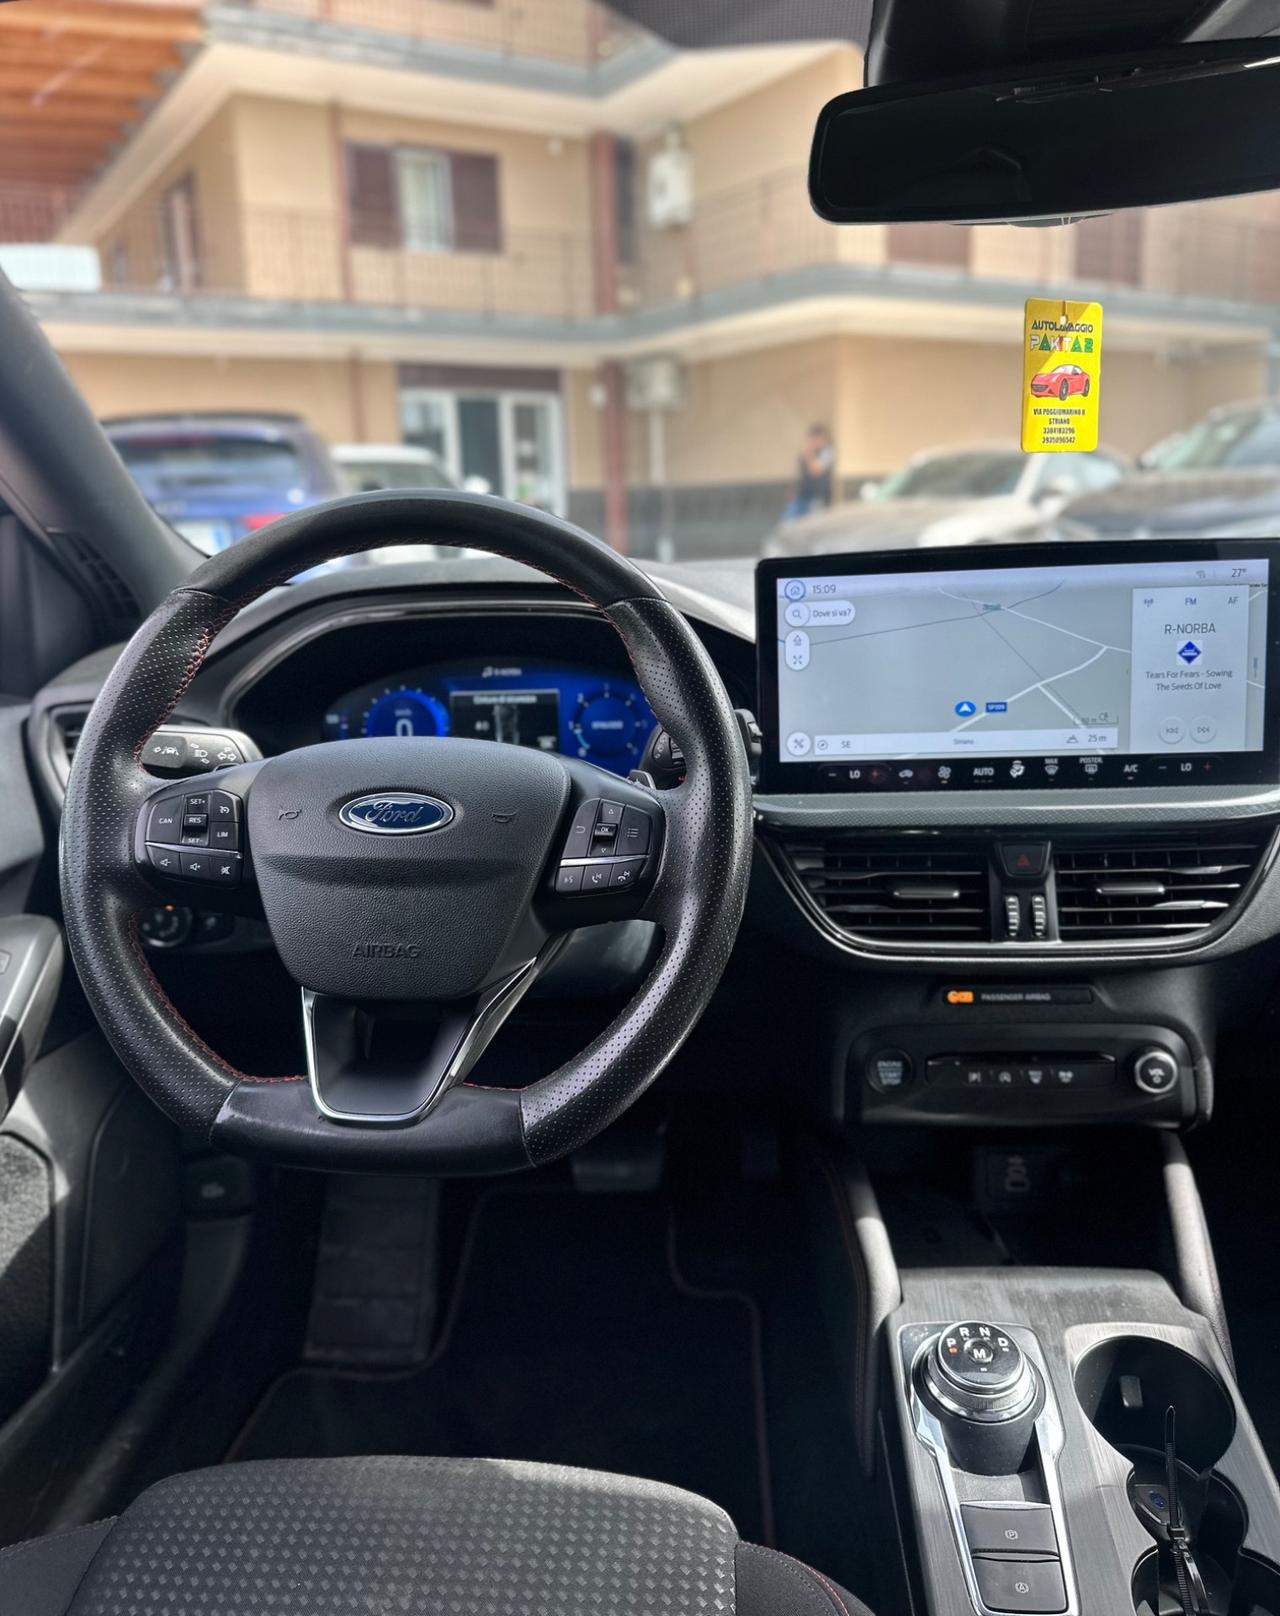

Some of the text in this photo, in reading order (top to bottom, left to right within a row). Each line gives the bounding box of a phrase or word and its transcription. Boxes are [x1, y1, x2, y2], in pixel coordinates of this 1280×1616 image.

[812, 584, 837, 594] 15:09
[1185, 597, 1197, 606] FM
[1228, 596, 1239, 605] AF
[812, 608, 831, 618] Dove
[1164, 623, 1216, 635] R-NORBA
[1146, 670, 1164, 679] Tears
[1167, 670, 1178, 679] For
[1180, 670, 1200, 679] Fears
[1206, 668, 1233, 680] Sowing
[1156, 681, 1222, 691] The Seeds Of Love
[1088, 734, 1098, 743] 25
[973, 768, 994, 776] AUTO
[1123, 764, 1139, 774] A/C
[1180, 763, 1193, 773] LO
[850, 770, 860, 779] LO
[365, 801, 424, 823] Ford
[158, 817, 173, 825] CAN
[351, 943, 420, 959] AIRBAG
[959, 1327, 970, 1336] R
[979, 1327, 990, 1336] N
[946, 1338, 956, 1348] P
[998, 1337, 1009, 1347] D
[973, 1348, 986, 1359] M
